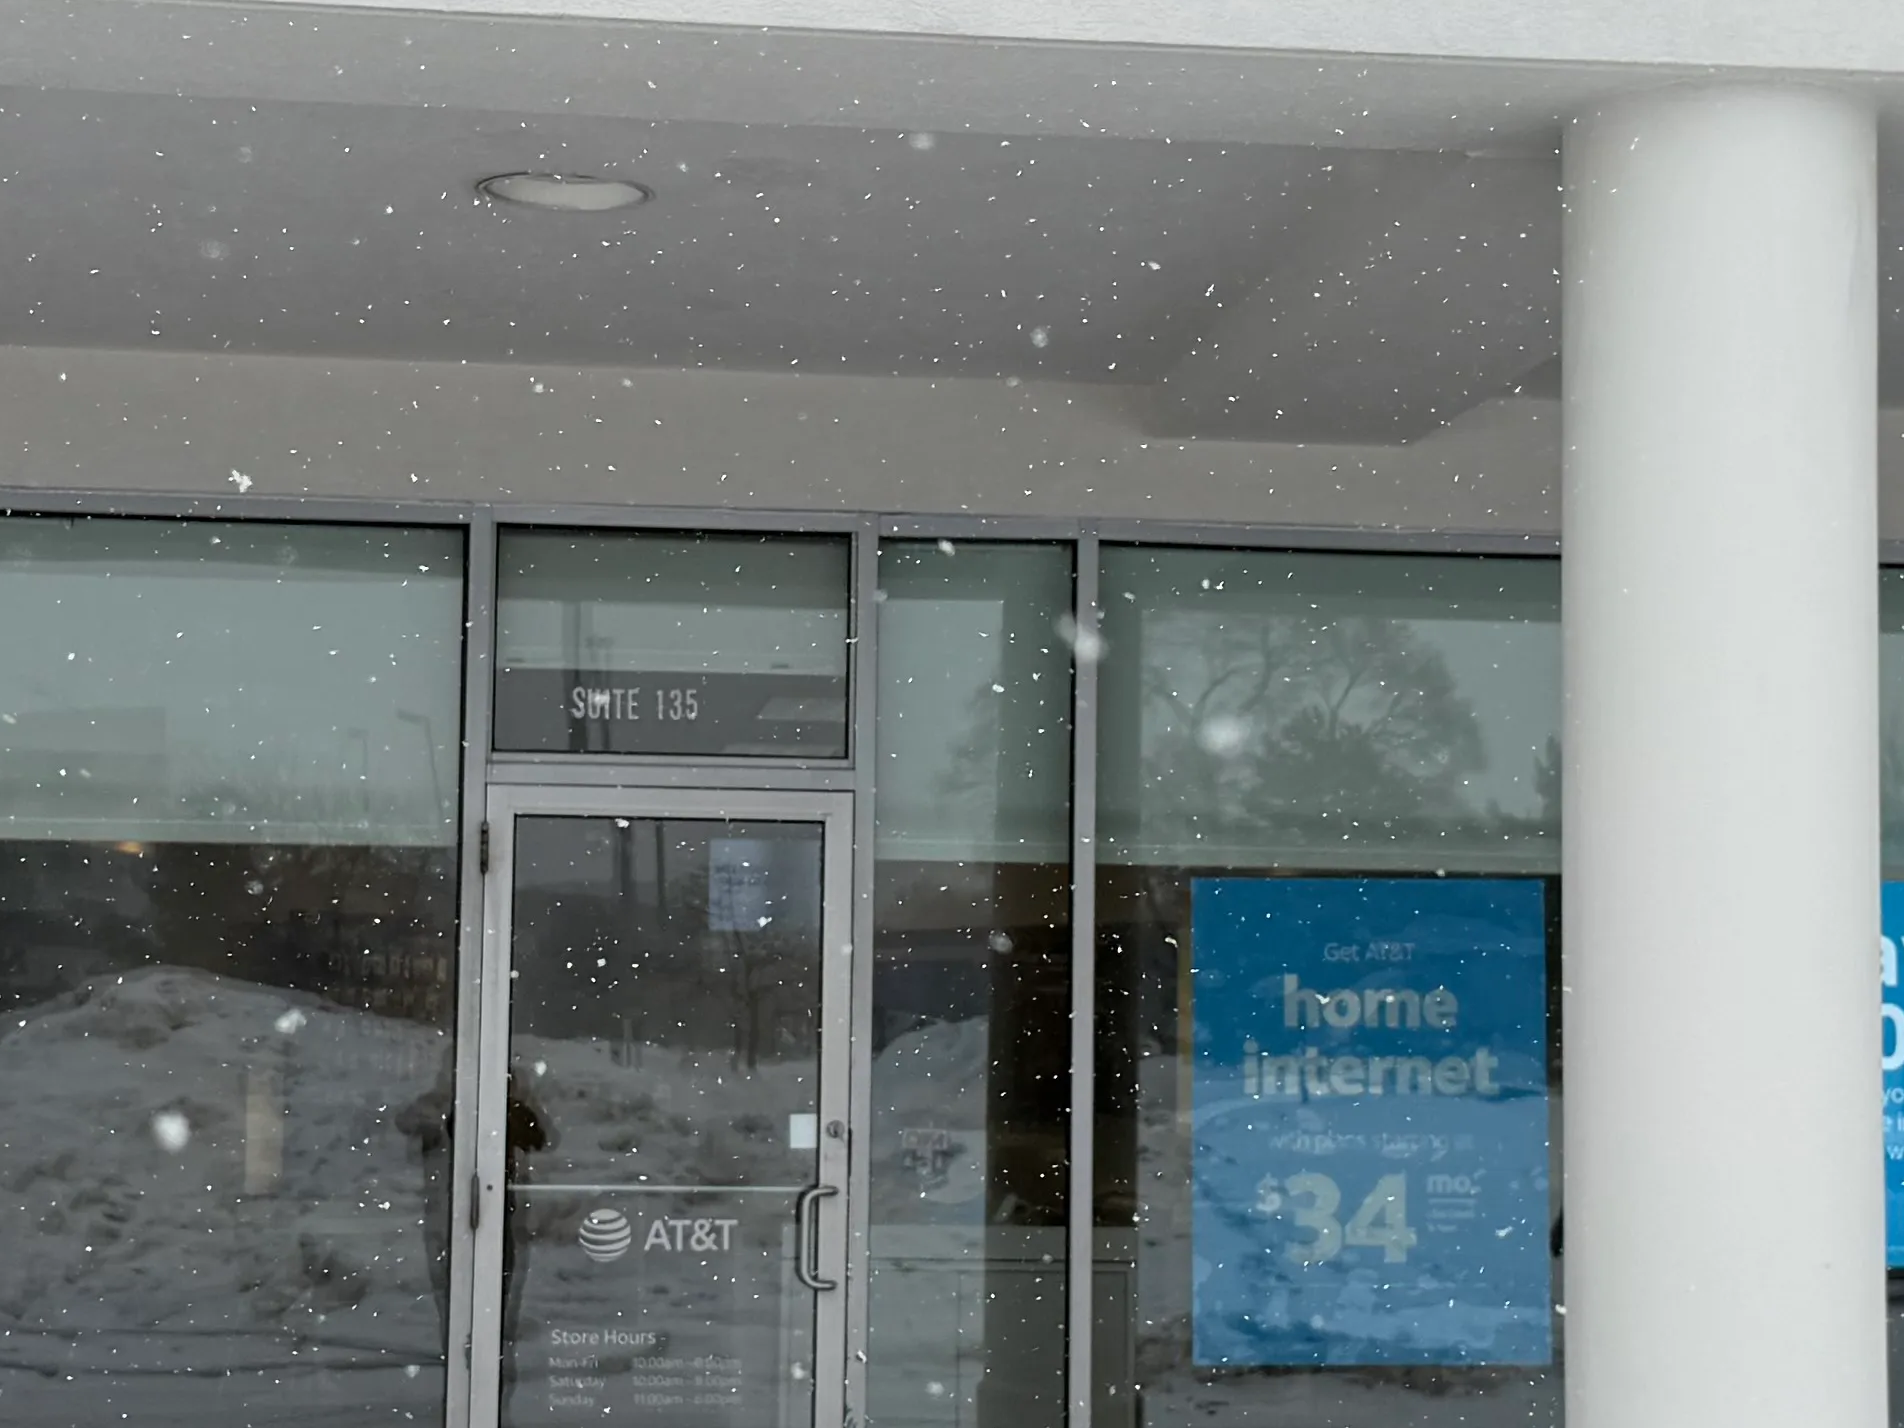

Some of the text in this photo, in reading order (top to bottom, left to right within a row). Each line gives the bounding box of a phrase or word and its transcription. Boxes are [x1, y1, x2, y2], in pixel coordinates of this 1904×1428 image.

[571, 687, 698, 720] SUITE 135
[1323, 942, 1360, 963] Get
[1283, 973, 1459, 1029] home
[1243, 1039, 1500, 1096] internet
[644, 1219, 738, 1252] AT&T
[551, 1329, 657, 1345] Store Hours
